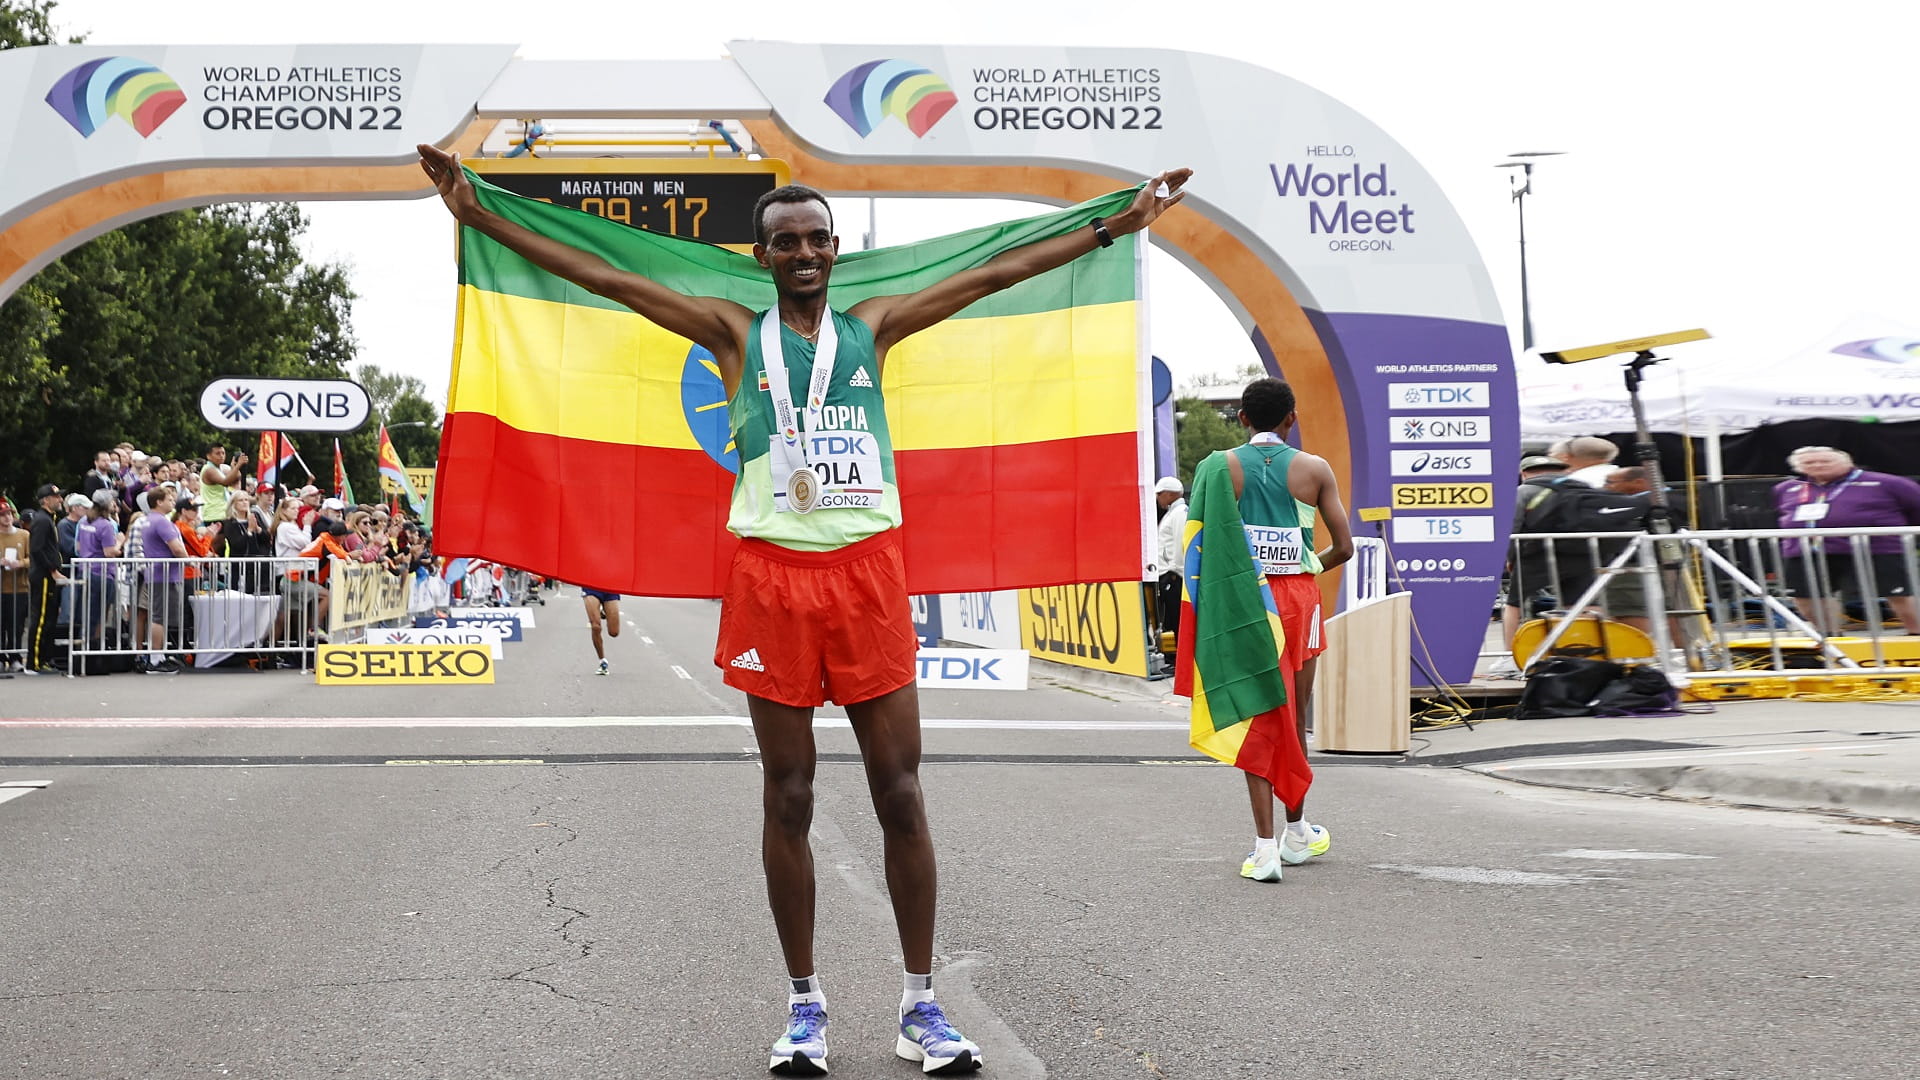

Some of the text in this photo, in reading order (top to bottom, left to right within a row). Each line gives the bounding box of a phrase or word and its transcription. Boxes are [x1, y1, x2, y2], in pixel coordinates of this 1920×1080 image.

[203, 67, 402, 83] WORLD ATHLETICS
[973, 69, 1161, 83] WORLD ATHLETICS
[203, 85, 402, 102] CHAMPIONSHIPS
[973, 86, 1162, 102] CHAMPIONSHIPS
[1307, 145, 1356, 158] HELLO,
[561, 181, 685, 195] MARATHON MEN
[1269, 163, 1397, 197] World.
[1309, 200, 1415, 234] Meet
[1329, 240, 1395, 251] OREGON.
[1376, 363, 1499, 373] WORLD ATHLETICS PARTNERS
[1421, 388, 1473, 403] TDK
[266, 391, 350, 418] QNB
[1430, 421, 1477, 437] QNB
[811, 436, 866, 455] TDK
[1431, 457, 1472, 469] asics
[808, 462, 862, 485] OLA
[817, 495, 869, 507] GON22
[1397, 486, 1488, 505] SEIKO
[1426, 519, 1462, 535] TBS
[1254, 529, 1292, 543] TDK
[1253, 545, 1299, 561] EMEW
[1030, 582, 1121, 664] SEIKO
[324, 649, 490, 678] SEIKO
[731, 658, 765, 673] adidas
[916, 658, 1002, 681] TDK
